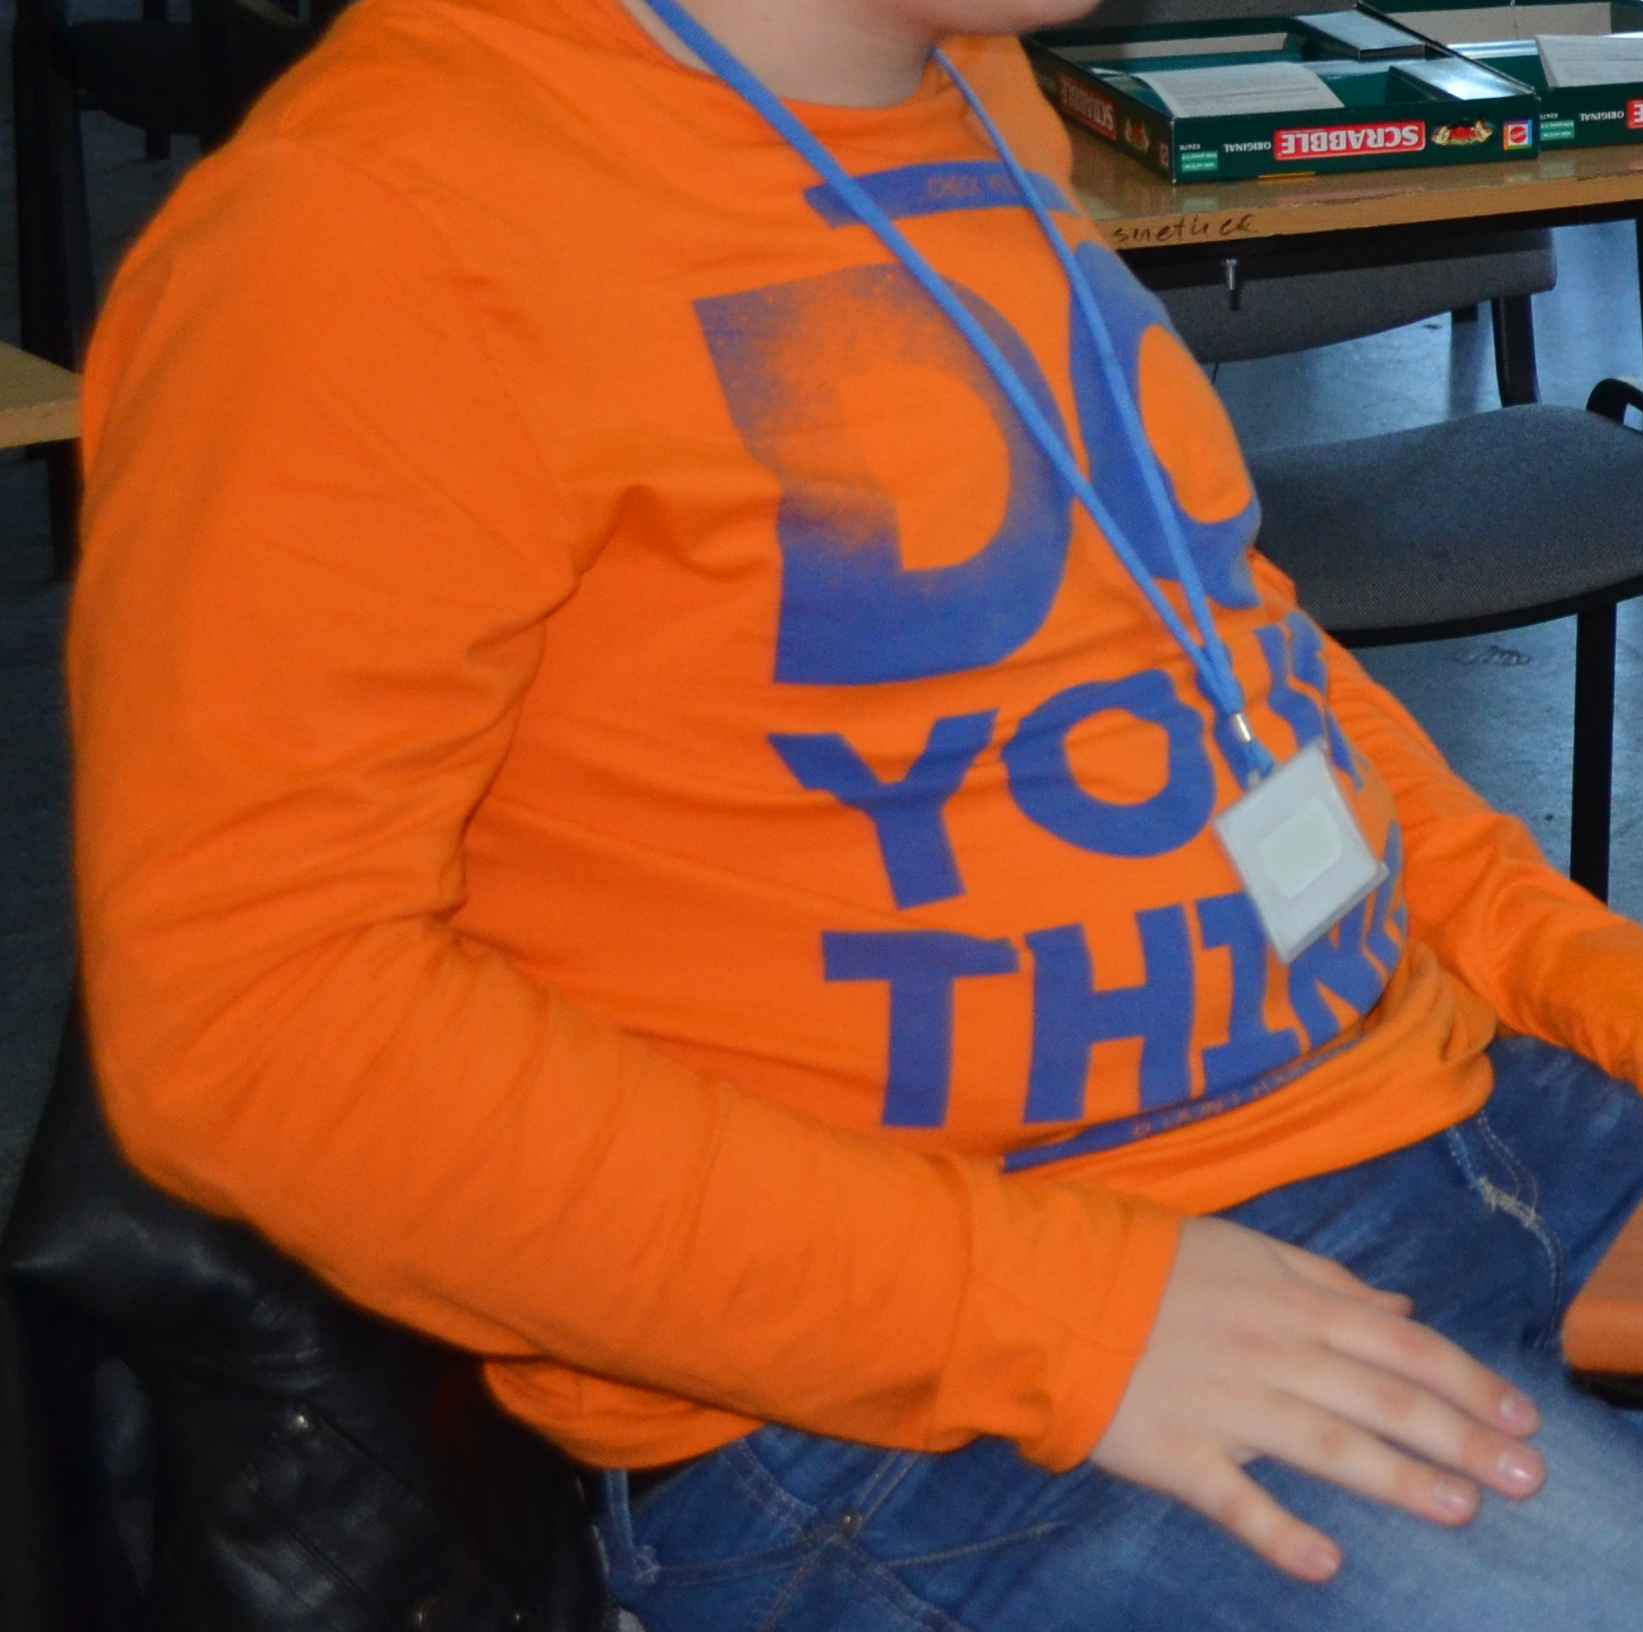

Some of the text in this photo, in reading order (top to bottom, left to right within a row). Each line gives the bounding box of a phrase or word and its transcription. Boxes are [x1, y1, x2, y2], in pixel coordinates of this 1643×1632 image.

[1580, 110, 1624, 122] ORIGINAL
[1224, 125, 1420, 155] ORIGINAL SCRABBLE
